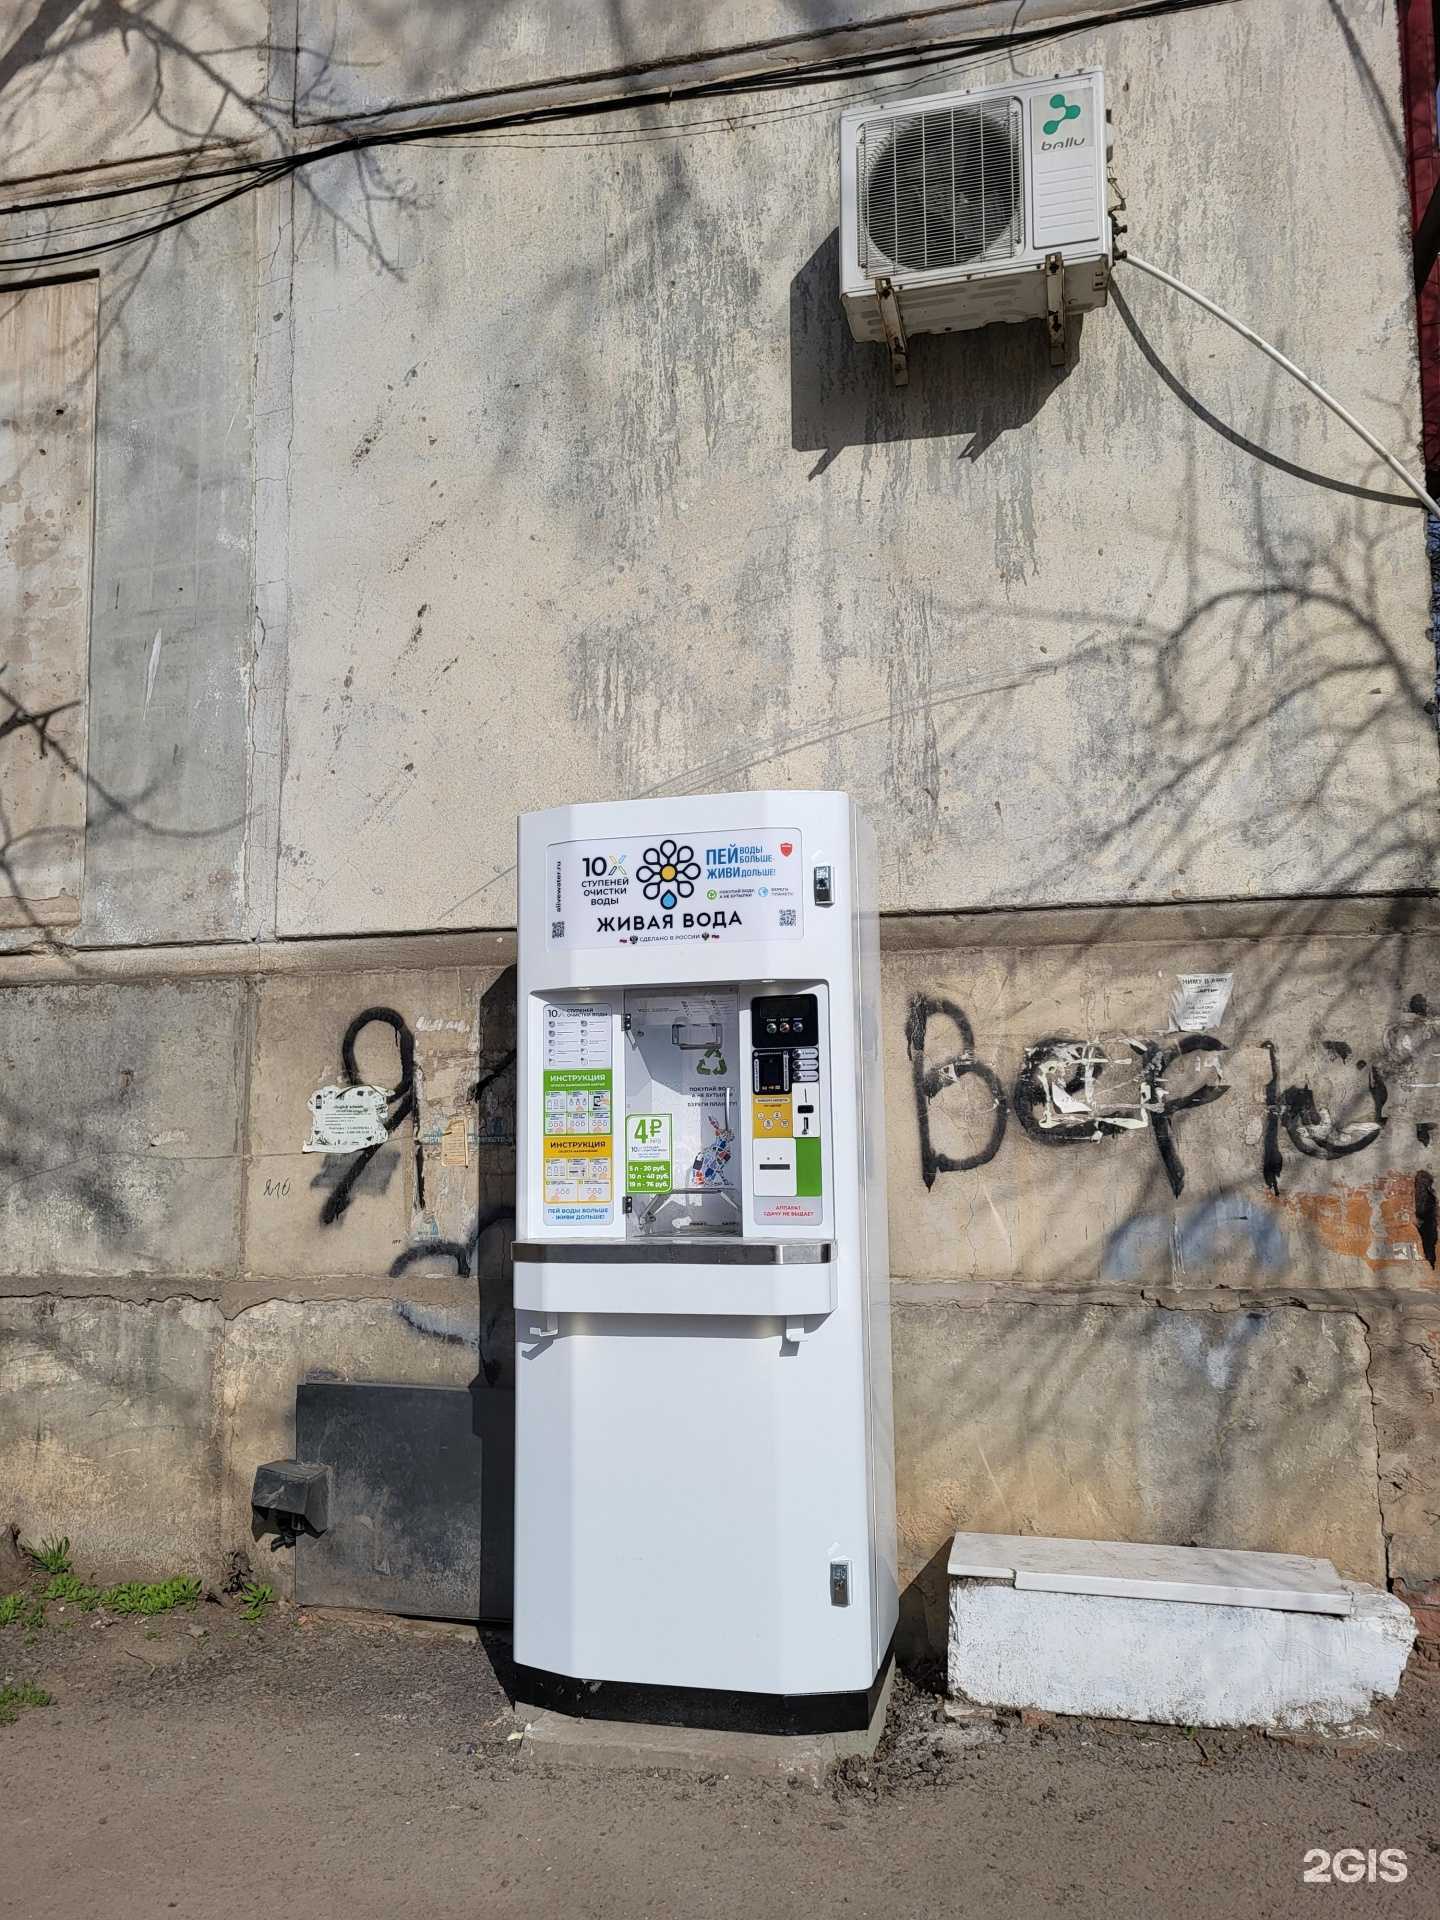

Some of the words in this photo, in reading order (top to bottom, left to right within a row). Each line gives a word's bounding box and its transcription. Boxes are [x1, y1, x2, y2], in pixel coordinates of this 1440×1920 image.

[1041, 137, 1085, 151] ballu
[706, 843, 738, 865] ПЕЙ
[740, 845, 763, 854] ВОДЫ
[707, 866, 740, 880] ЖИВИ
[581, 877, 629, 888] СТУПЕНЕЙ
[583, 887, 627, 897] ОЧИСТКИ
[590, 898, 619, 906] ВОДЫ
[596, 914, 673, 932] ЖИВАЯ
[683, 911, 742, 928] ВОДА
[550, 1074, 606, 1082] ИНСТРУКЦИЯ
[550, 1141, 606, 1149] ИНСТРУКЦИЯ
